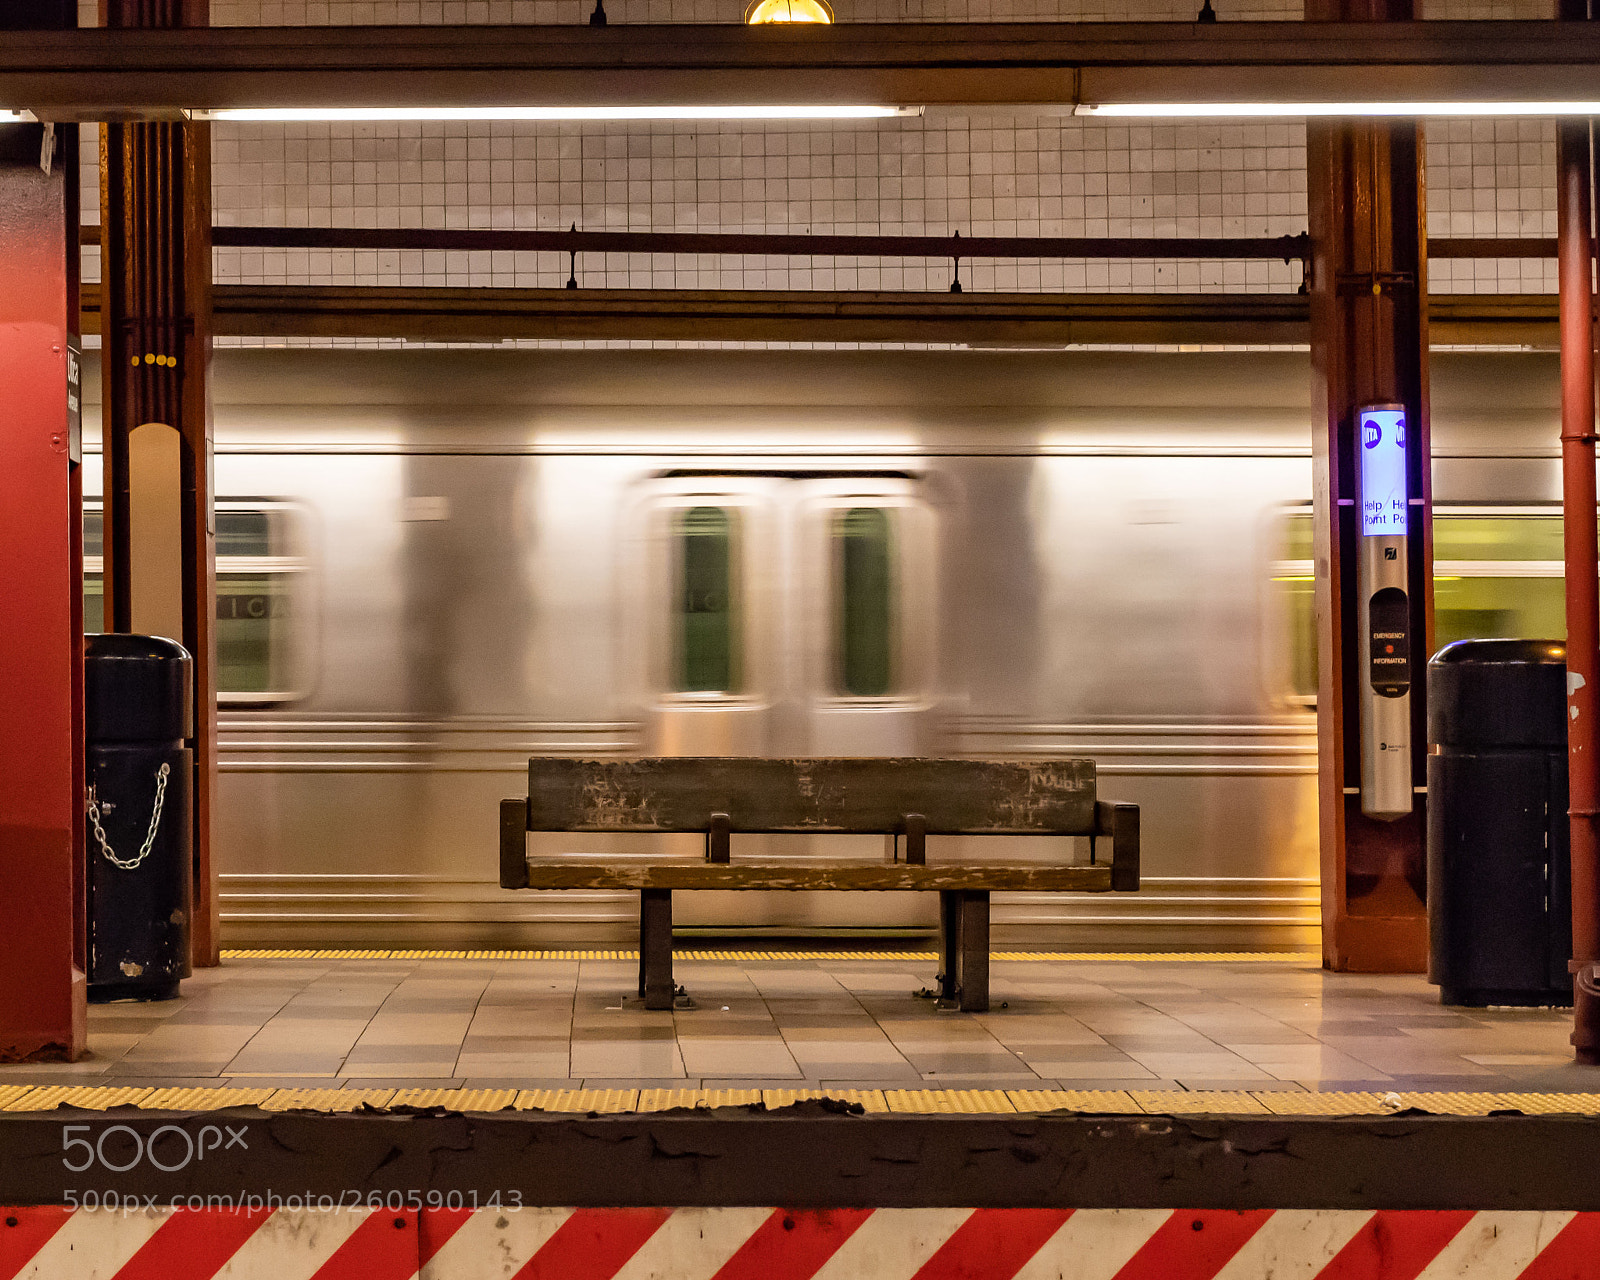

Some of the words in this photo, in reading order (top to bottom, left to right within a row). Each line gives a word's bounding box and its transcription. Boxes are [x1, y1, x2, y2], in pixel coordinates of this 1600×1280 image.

[1365, 500, 1382, 512] Help
[1365, 514, 1387, 525] Point
[1373, 632, 1405, 640] EMERGENCY
[1373, 657, 1407, 665] INFORMATION
